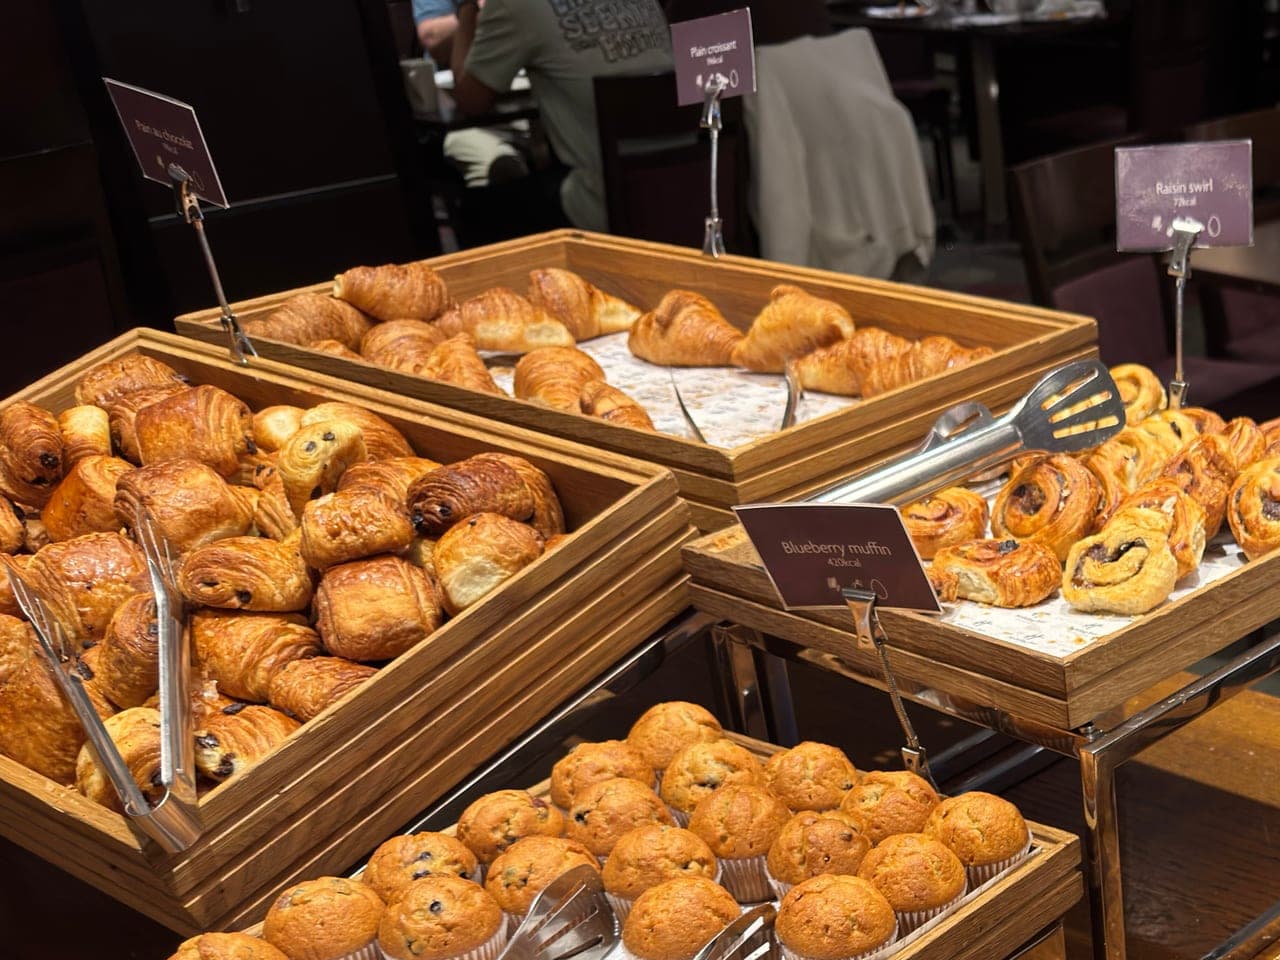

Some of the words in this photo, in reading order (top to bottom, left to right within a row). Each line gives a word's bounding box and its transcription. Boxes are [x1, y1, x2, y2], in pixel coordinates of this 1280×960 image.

[1156, 181, 1186, 194] Raisin
[1188, 178, 1213, 193] swirl
[781, 541, 845, 556] Blueberry
[849, 541, 892, 556] muffin
